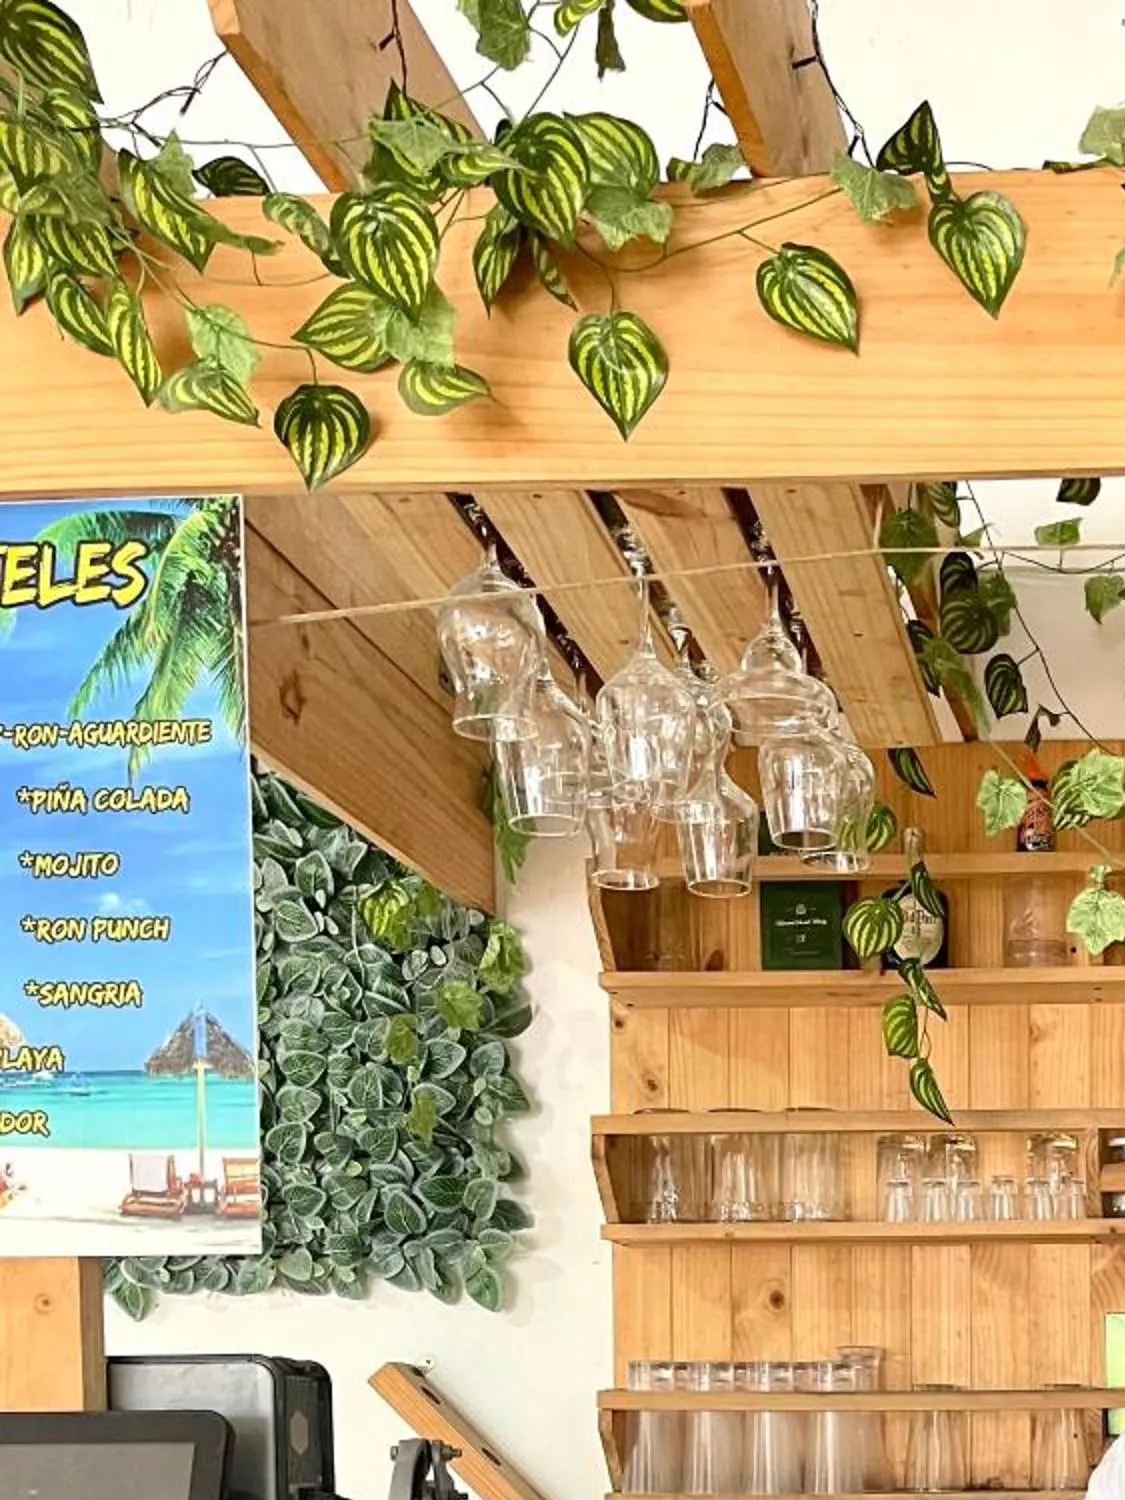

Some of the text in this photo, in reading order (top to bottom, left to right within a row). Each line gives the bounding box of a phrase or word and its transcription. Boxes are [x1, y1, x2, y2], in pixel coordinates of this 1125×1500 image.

[0, 540, 149, 609] ELES
[0, 719, 212, 749] -RON-AGUARDIENTE
[94, 786, 190, 814] COLADA
[92, 916, 171, 942] PUNCH
[0, 1045, 66, 1074] LAYA
